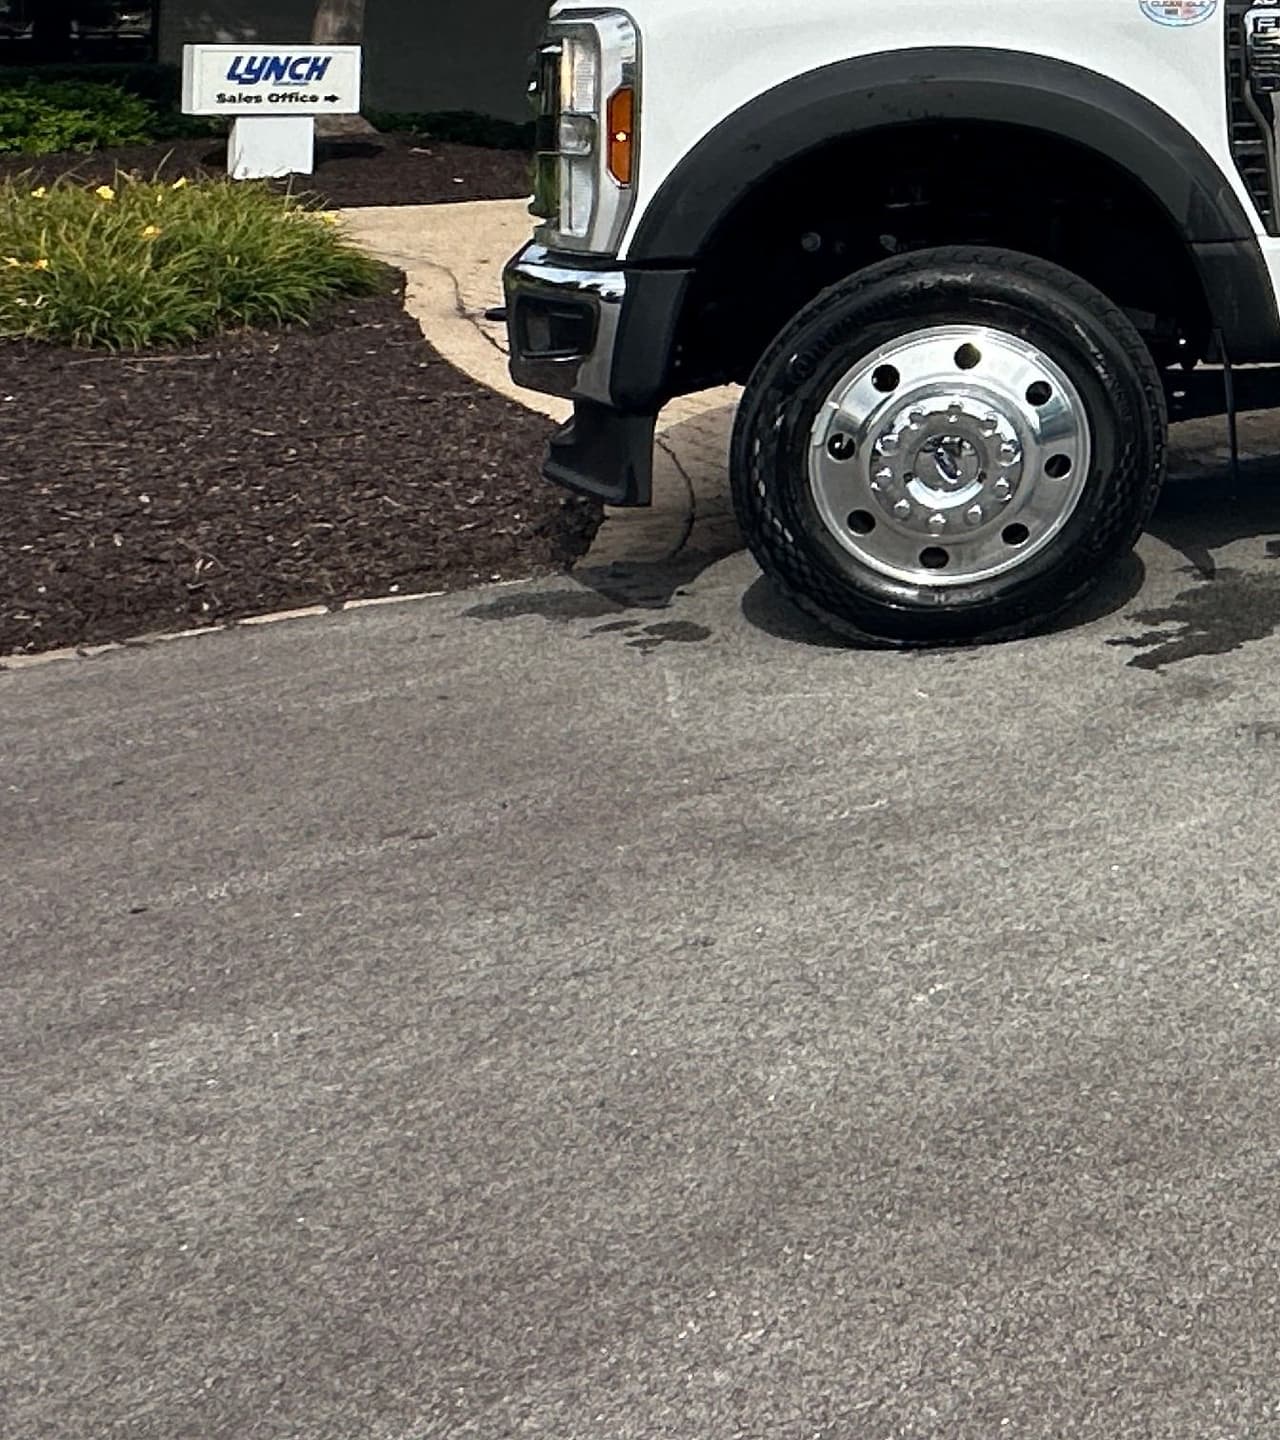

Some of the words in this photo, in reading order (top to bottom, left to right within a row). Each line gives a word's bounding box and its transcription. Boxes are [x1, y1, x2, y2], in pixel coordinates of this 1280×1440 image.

[226, 56, 333, 85] LYNCH
[216, 92, 263, 104] Sales
[267, 91, 319, 103] Office
